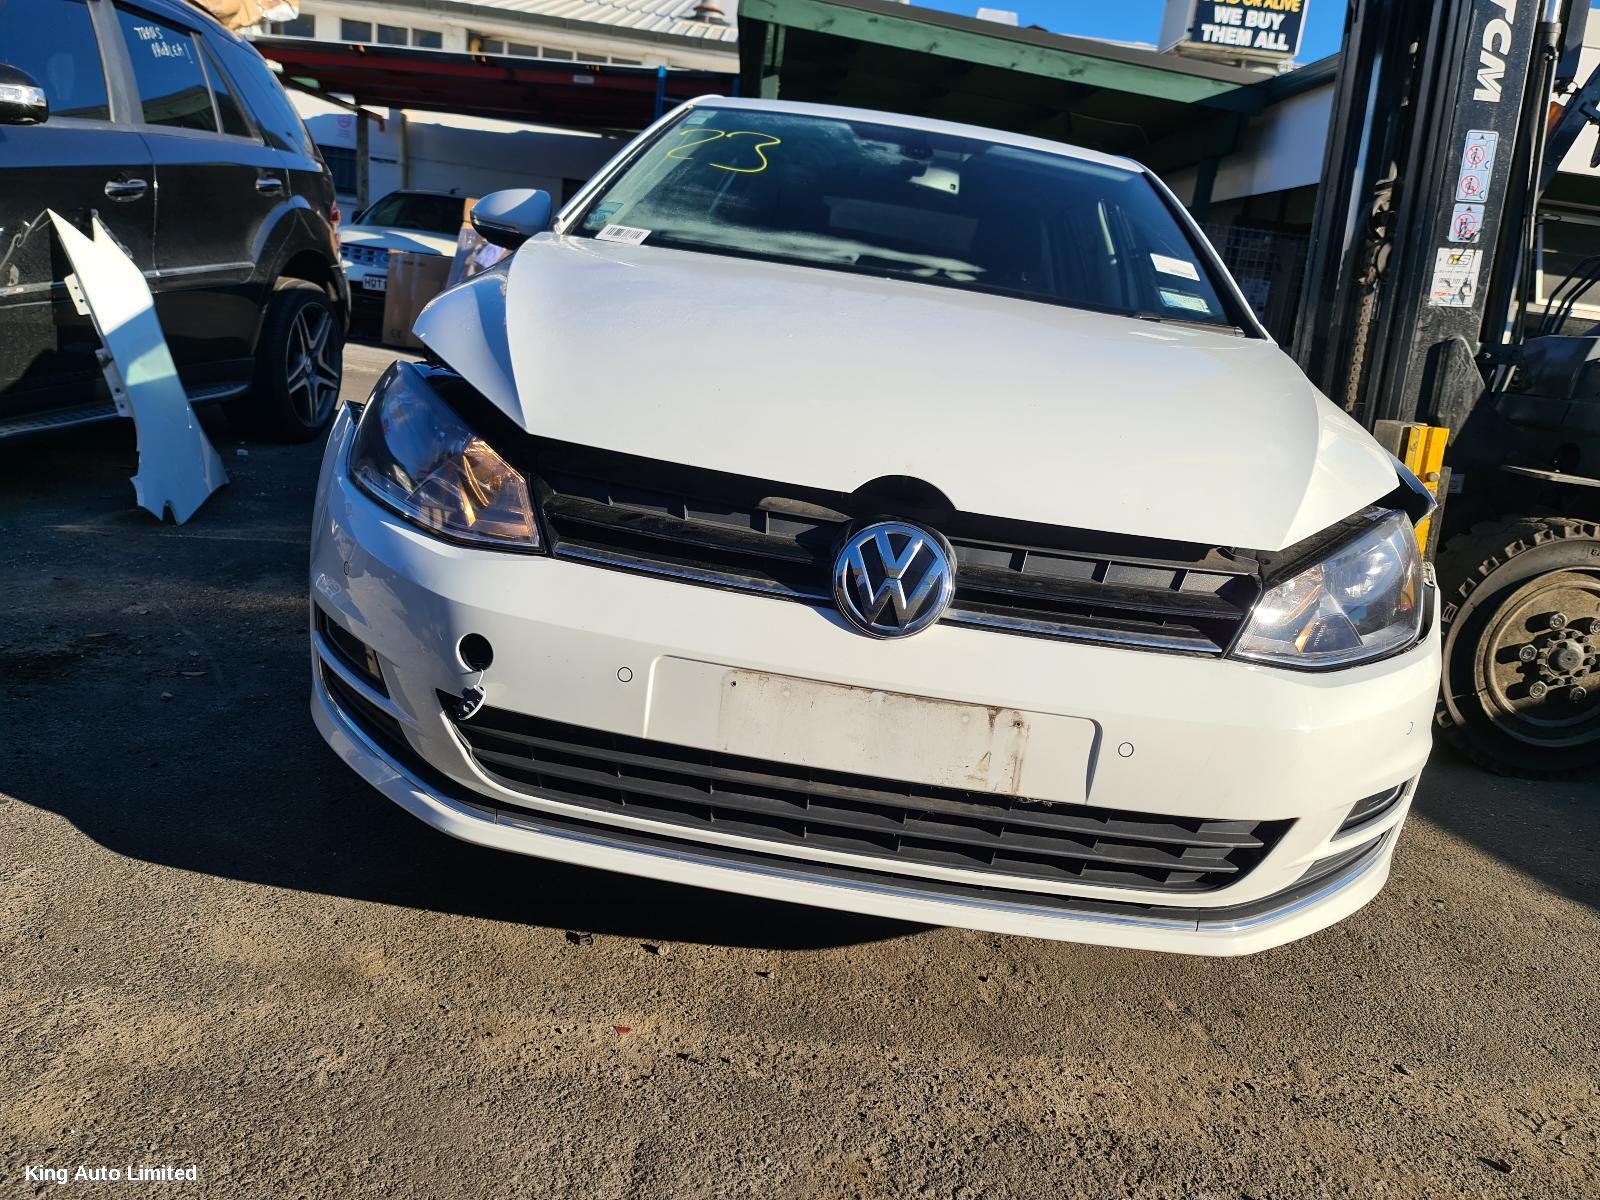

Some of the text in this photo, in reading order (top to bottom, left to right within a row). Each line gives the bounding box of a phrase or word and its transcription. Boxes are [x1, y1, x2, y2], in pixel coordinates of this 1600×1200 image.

[1214, 6, 1285, 30] WE BUY
[1263, 0, 1301, 12] ALIVE
[1201, 24, 1289, 51] THEM ALL
[667, 128, 781, 173] 23
